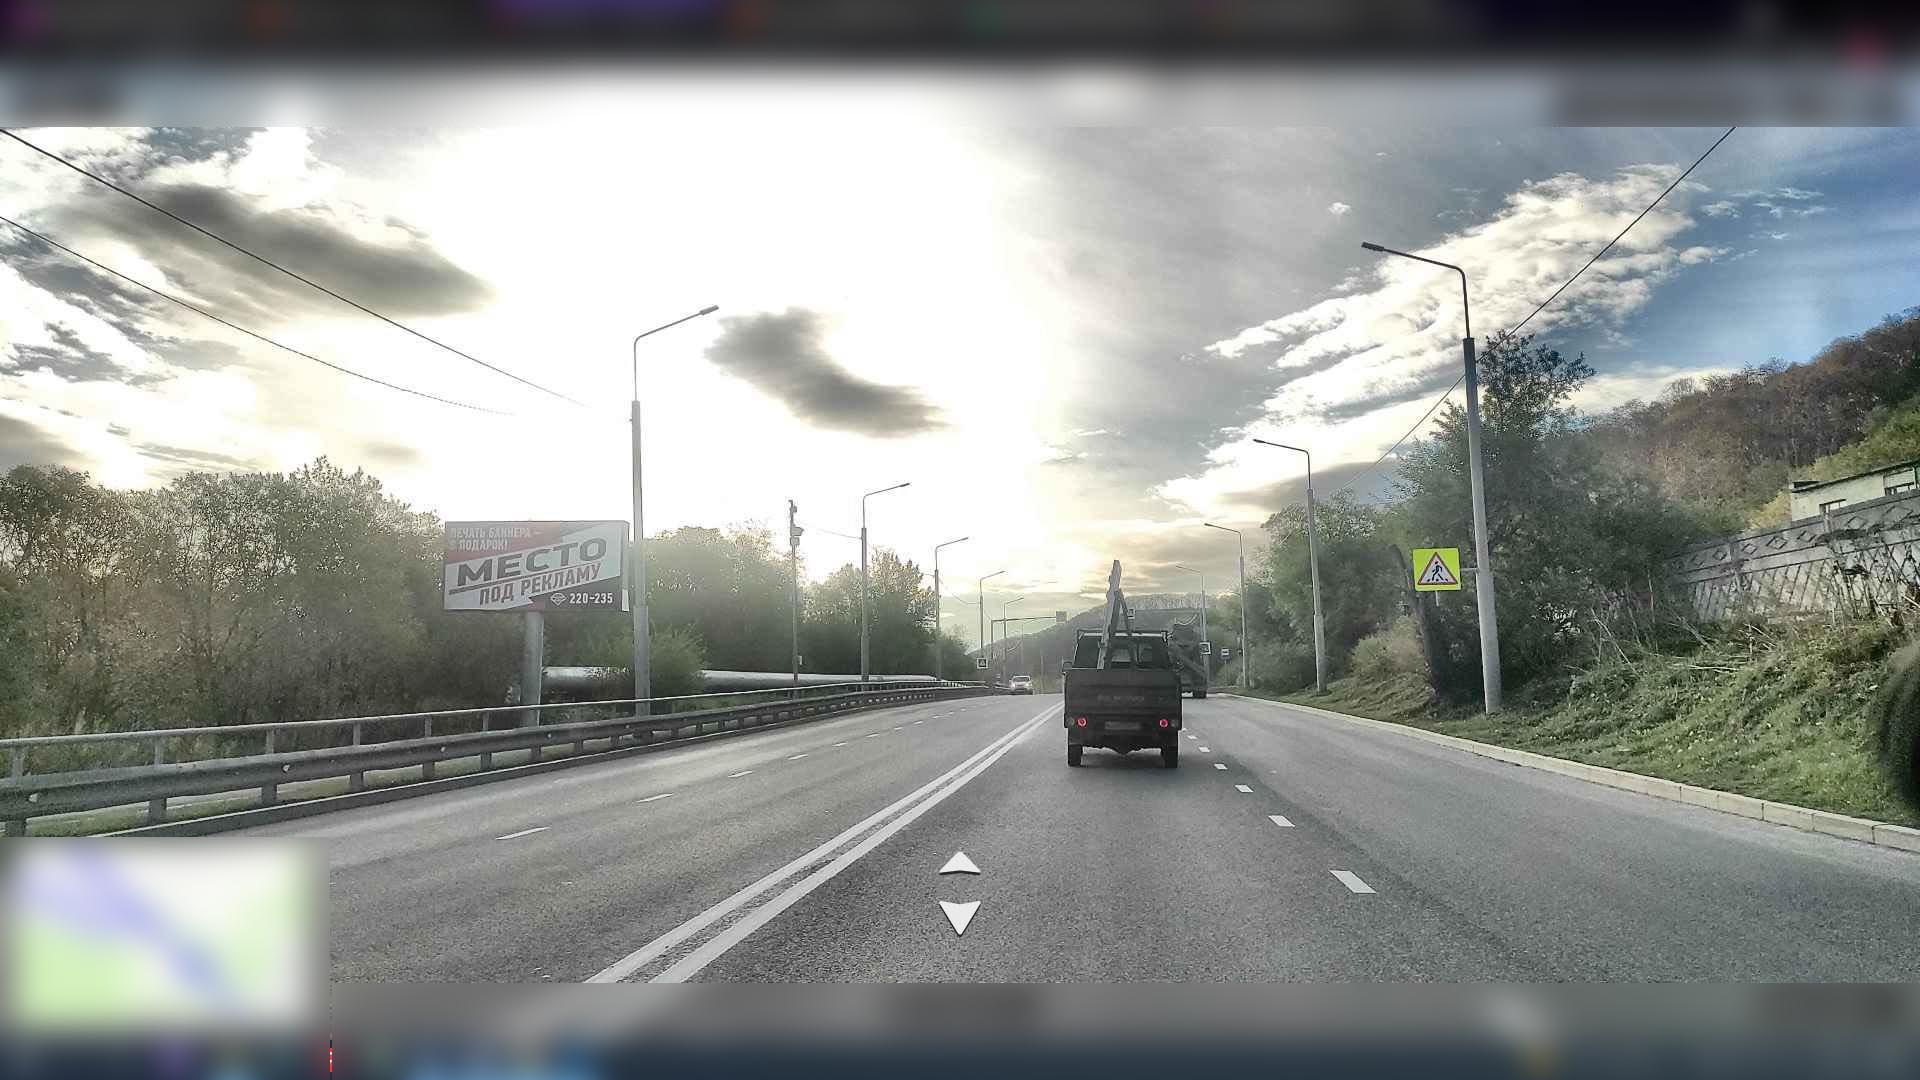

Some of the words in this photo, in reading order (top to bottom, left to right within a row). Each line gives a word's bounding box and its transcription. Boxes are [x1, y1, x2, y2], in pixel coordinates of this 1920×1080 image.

[450, 527, 486, 538] ПЕЧАТЬ
[488, 527, 531, 538] БАННЕРА
[459, 539, 508, 551] ПОДАРОК!
[457, 537, 607, 587] МЕСТО
[479, 582, 514, 606] ПОД
[521, 562, 601, 596] РЕКЛАМУ
[569, 592, 613, 604] 220-235
